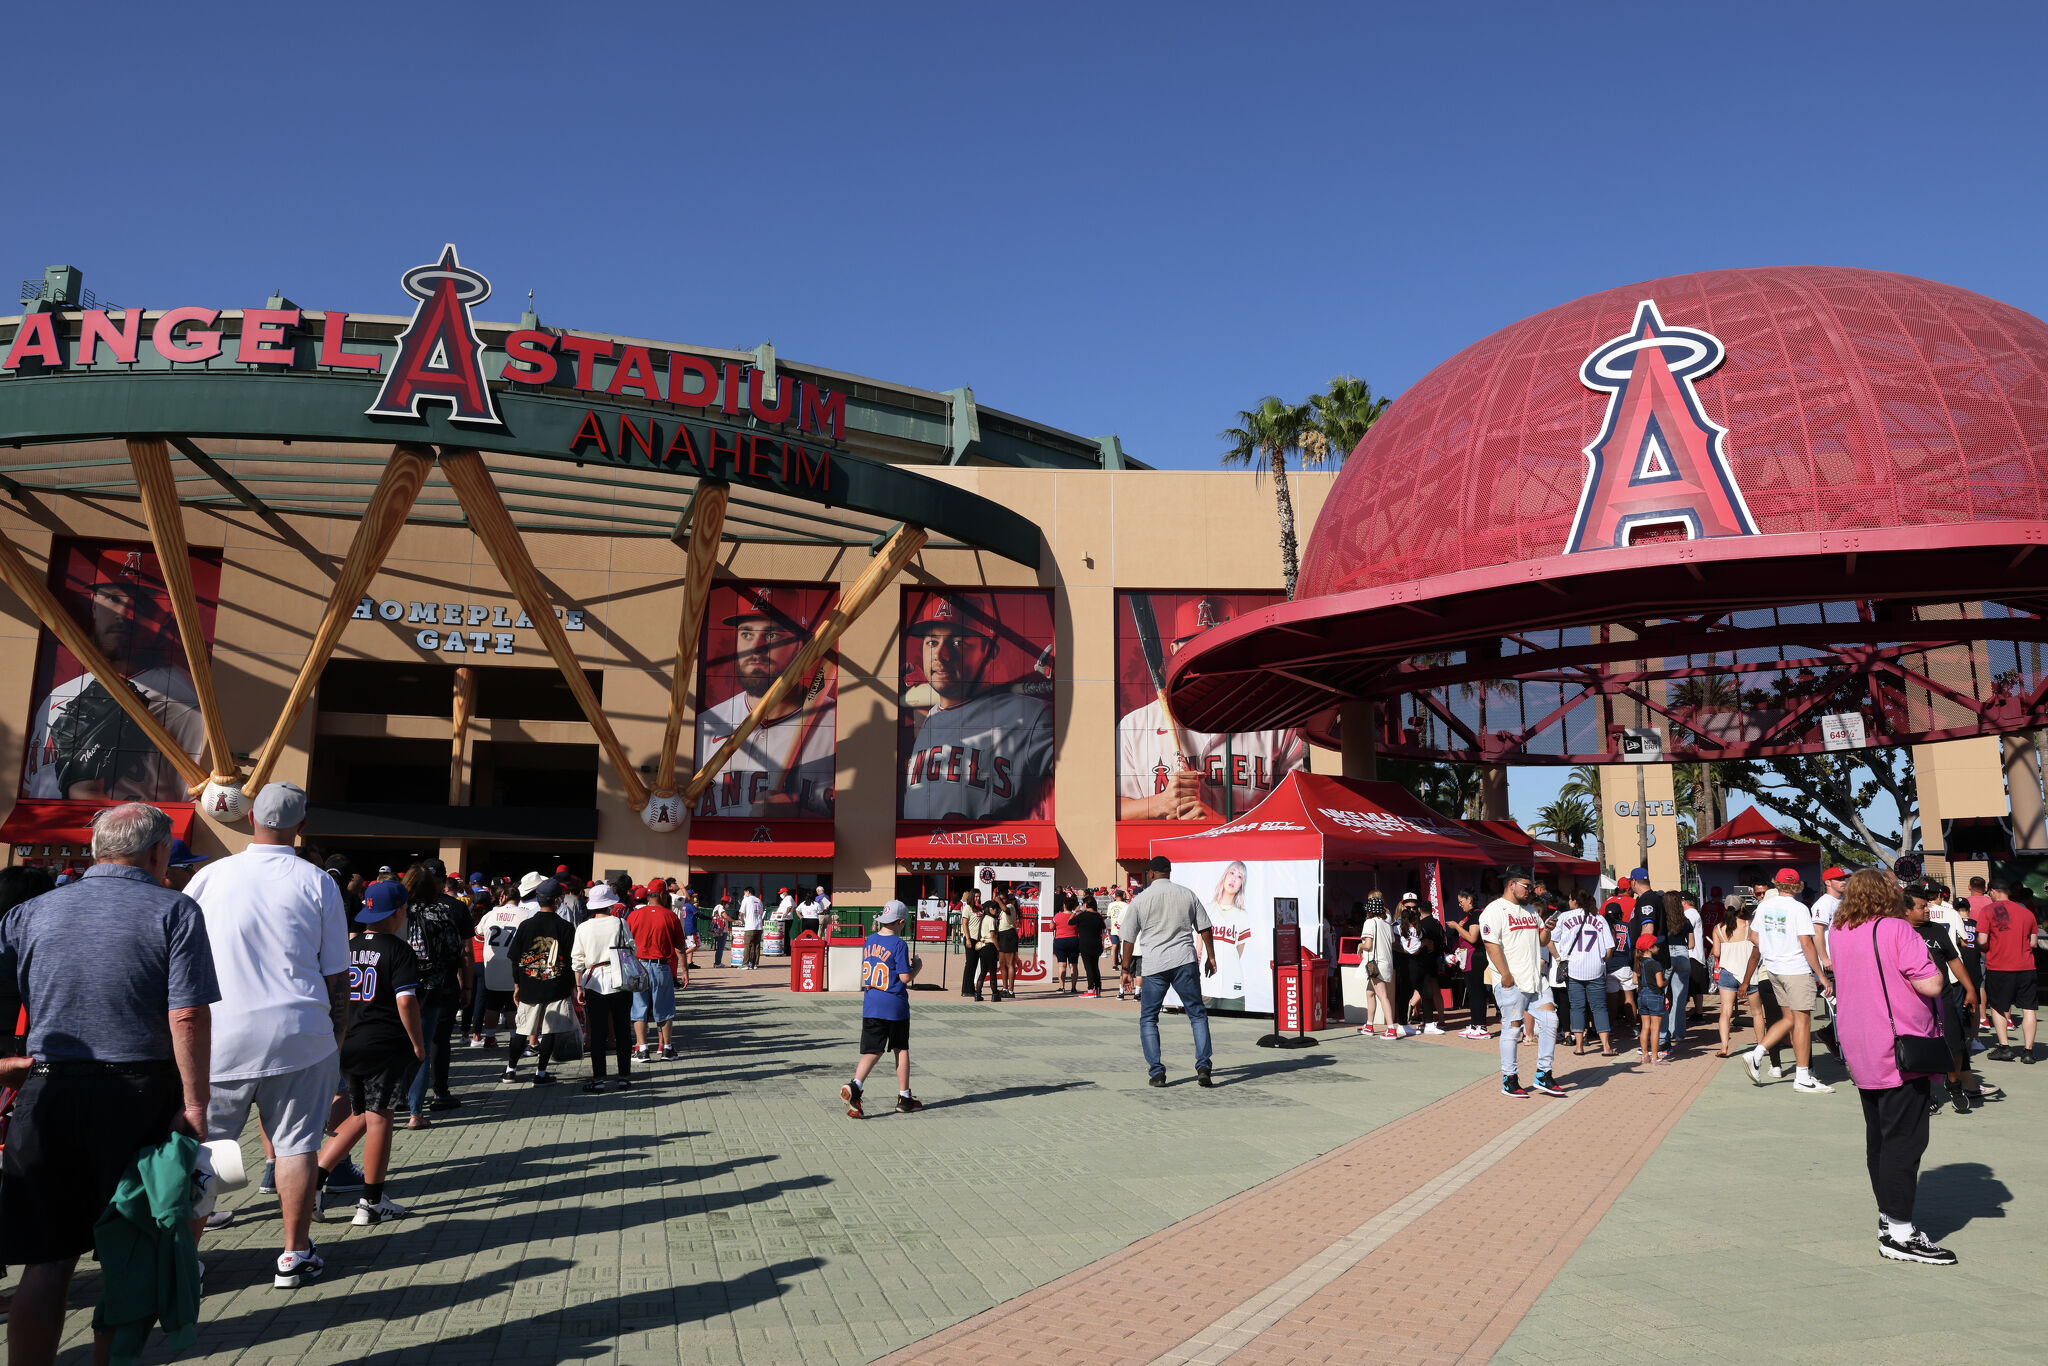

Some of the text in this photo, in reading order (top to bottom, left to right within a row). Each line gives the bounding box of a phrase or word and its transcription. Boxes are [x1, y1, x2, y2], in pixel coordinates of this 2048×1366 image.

[2, 306, 847, 442] ANGEL STADIUM
[569, 409, 832, 492] ANAHEIM
[416, 629, 516, 654] GATE
[906, 745, 1013, 800] NGELS
[929, 828, 1027, 846] ANGELS
[16, 845, 91, 857] WILL
[911, 861, 960, 871] TEAM
[495, 912, 517, 923] TROUT
[488, 925, 517, 947] 27
[1577, 930, 1598, 953] 17
[349, 949, 381, 967] LONSO
[349, 966, 377, 1002] 20
[862, 961, 890, 992] 20
[1286, 976, 1298, 1030] RECYCLE
